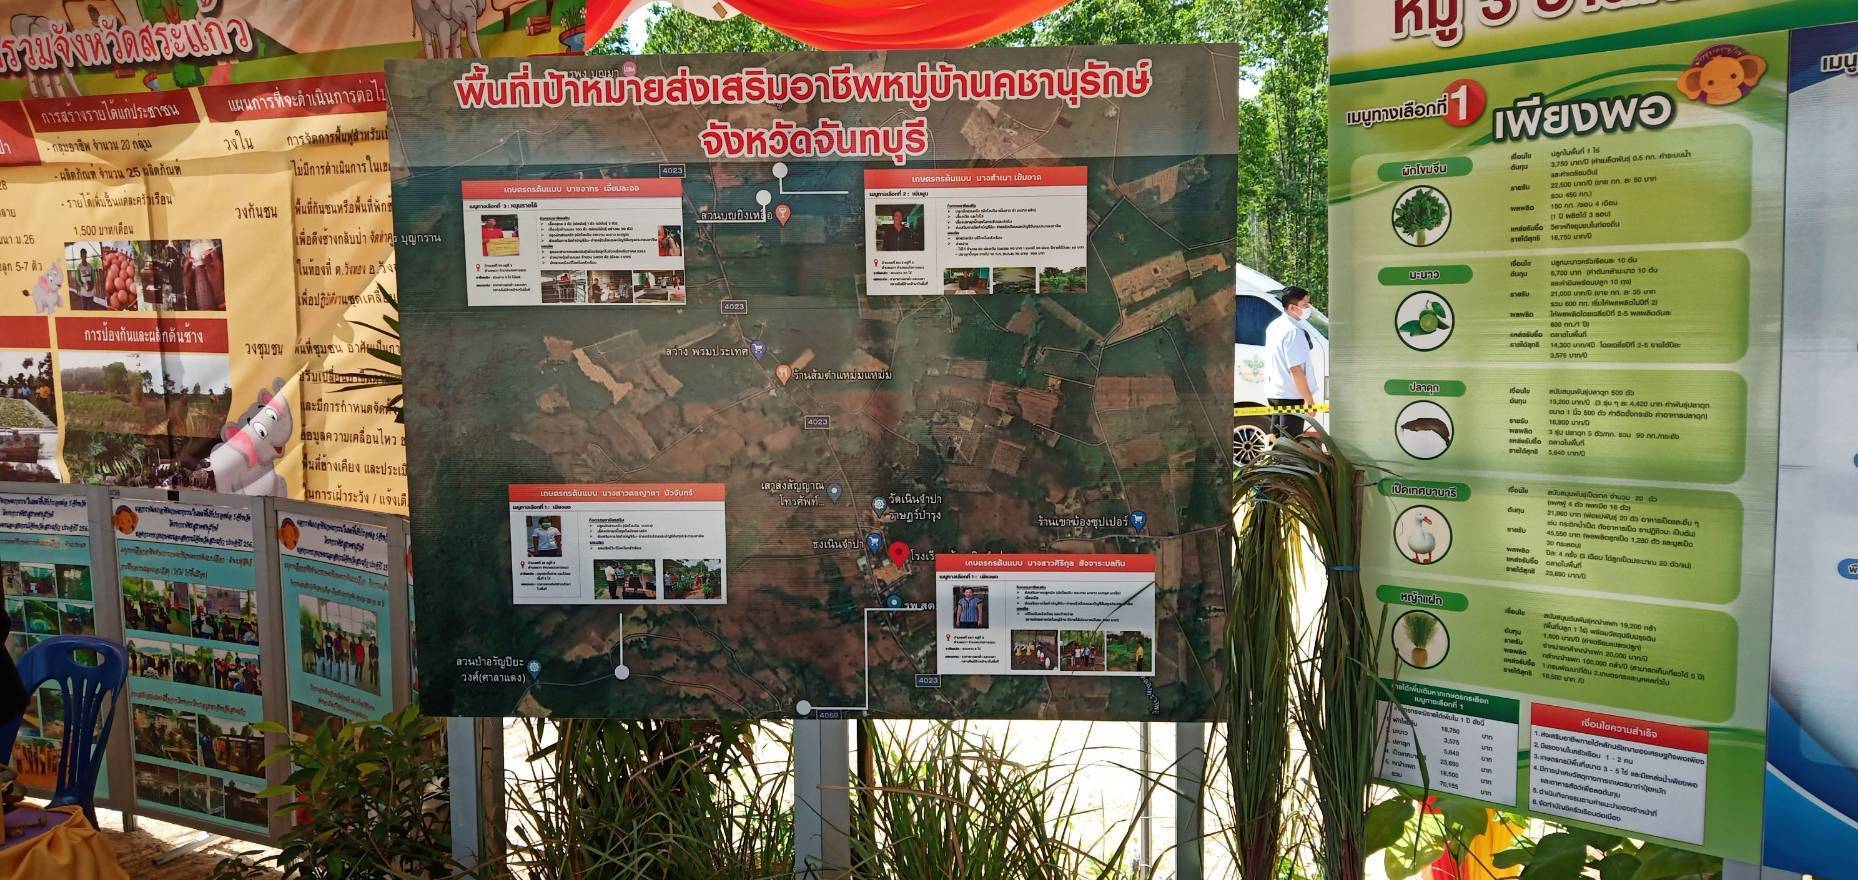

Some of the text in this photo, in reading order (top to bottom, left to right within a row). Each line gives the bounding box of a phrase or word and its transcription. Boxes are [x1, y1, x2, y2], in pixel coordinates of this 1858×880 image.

[456, 58, 1153, 113] พื้นที่เป้าหมายส่งเสริมอาชีพหมู่บ้านคชานุรักษ์
[1347, 85, 1467, 128] เมนูทางเลือกที่ 1
[1493, 94, 1676, 141] เพียงพอ
[224, 130, 254, 150] วงใน
[700, 116, 930, 167] จังหวัดจันทบุรี
[126, 167, 141, 178] 25
[235, 202, 278, 219] วงกันชน
[73, 225, 97, 236] 1,500
[1408, 268, 1441, 281] มะนาว
[245, 343, 284, 359] วงชุมชน
[1408, 382, 1440, 396] ปลาดุก
[807, 418, 828, 426] 4023
[1581, 718, 1658, 738] เงื่อนไขความสำเร็จ
